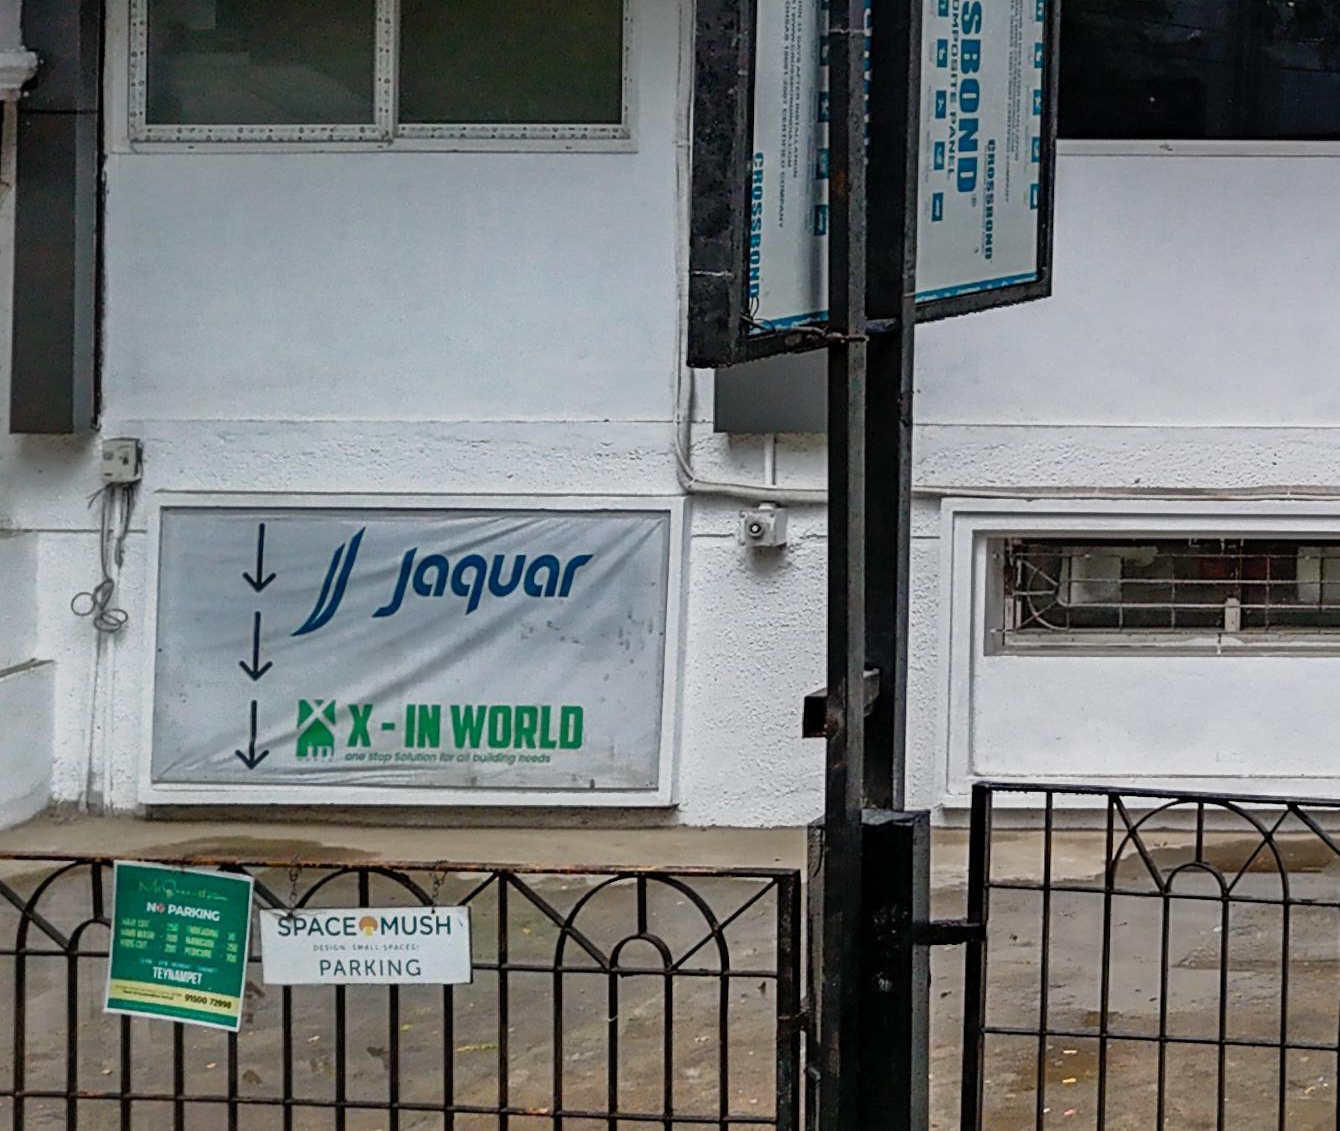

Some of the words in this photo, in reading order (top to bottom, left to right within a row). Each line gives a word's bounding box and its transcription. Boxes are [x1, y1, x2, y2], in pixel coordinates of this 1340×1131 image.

[948, 111, 957, 181] PANEL
[985, 138, 996, 260] CROSSBOND
[748, 152, 764, 298] CROSSBOND
[372, 547, 594, 618] Jaquar
[347, 704, 373, 747] X
[405, 704, 441, 748] IN
[450, 705, 584, 749] WORLD
[345, 753, 365, 761] one
[368, 752, 393, 764] stop
[439, 752, 456, 762] for
[456, 752, 471, 762] all
[473, 752, 517, 765] building
[518, 754, 550, 763] needs
[167, 904, 221, 922] PARKING
[278, 916, 357, 936] SPACE
[380, 915, 452, 936] MUSH
[319, 959, 422, 977] PARKING
